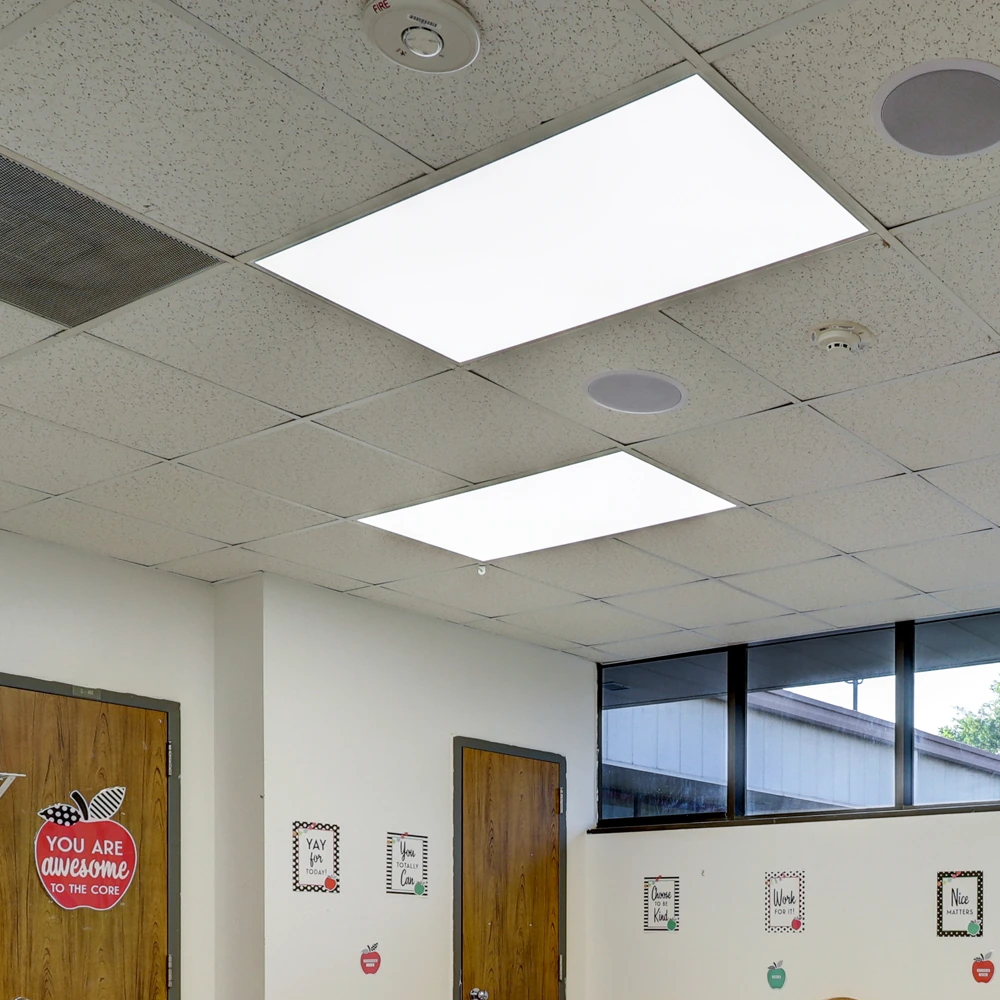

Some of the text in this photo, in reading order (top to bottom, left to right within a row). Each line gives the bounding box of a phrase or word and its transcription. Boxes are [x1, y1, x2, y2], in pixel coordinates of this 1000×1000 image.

[372, 0, 391, 13] FIRE
[46, 835, 124, 856] YOU ARE
[306, 838, 327, 851] YAY
[400, 841, 416, 861] You
[310, 852, 323, 867] for
[396, 861, 419, 869] TOTALLY
[41, 856, 130, 880] awesome
[306, 868, 328, 876] TODAY!
[400, 869, 415, 887] Can
[50, 882, 120, 896] TO THE CORE
[651, 885, 672, 901] Choose
[773, 888, 796, 907] Work
[951, 888, 969, 907] Nice
[653, 907, 669, 923] Kind
